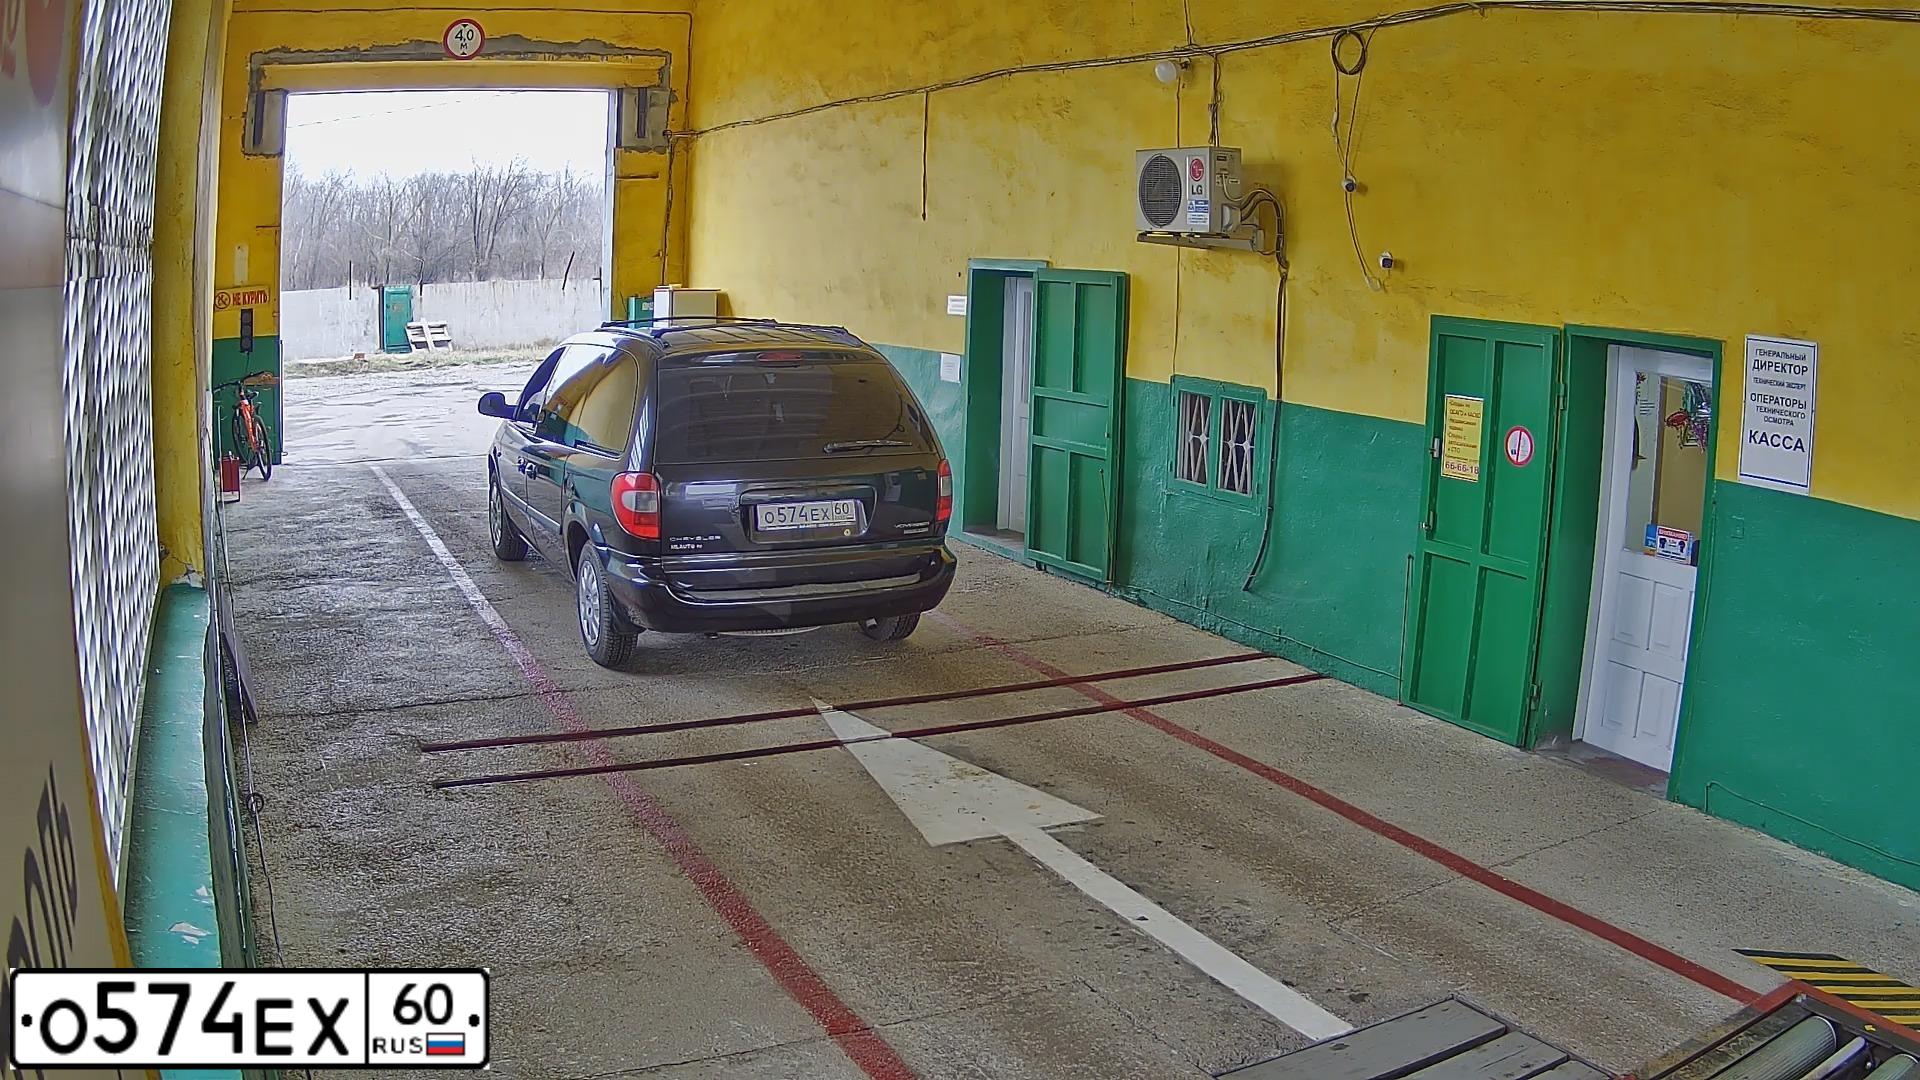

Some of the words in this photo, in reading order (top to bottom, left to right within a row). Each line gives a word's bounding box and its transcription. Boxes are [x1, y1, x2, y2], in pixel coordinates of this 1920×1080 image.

[454, 29, 474, 42] 4,0
[1191, 184, 1203, 195] LG
[232, 292, 241, 306] НЕ
[242, 290, 268, 305] КУРИТЬ
[1755, 348, 1806, 361] ГЕНЕРАЛЬНЫЙ
[1752, 358, 1809, 376] ДИРЕКТОР
[1750, 392, 1807, 410] ОПЕРАТОРЫ
[1756, 405, 1806, 420] ТЕХНИЧЕСКОГО
[1763, 416, 1794, 427] ОСМОТРА
[1748, 429, 1806, 453] КАССА
[764, 505, 831, 524] О574ЕХ
[834, 502, 850, 515] 60
